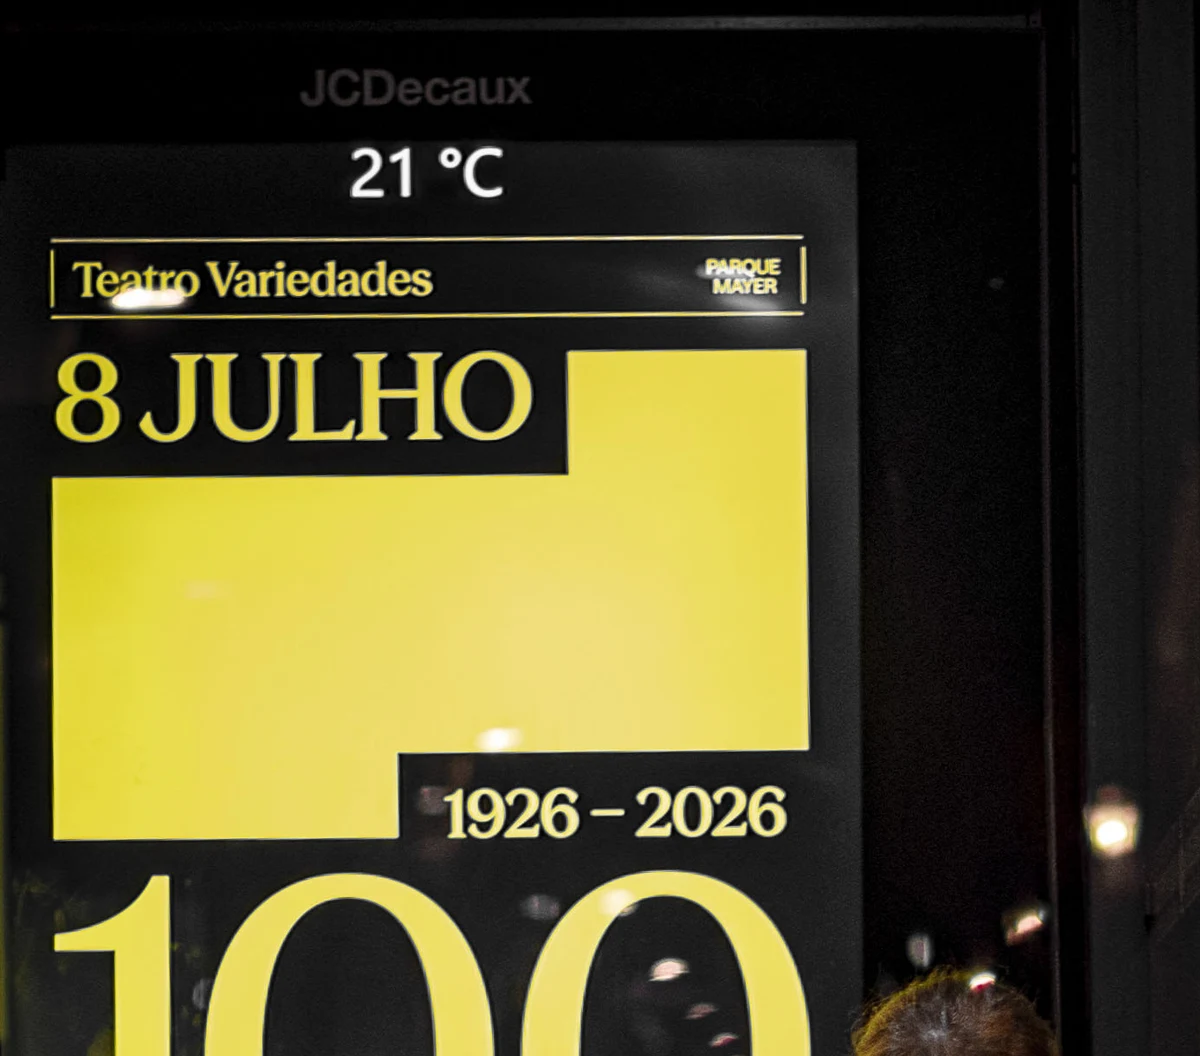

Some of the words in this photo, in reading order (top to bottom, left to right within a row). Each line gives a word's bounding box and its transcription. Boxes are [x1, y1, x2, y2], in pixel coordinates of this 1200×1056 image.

[301, 69, 531, 107] JCDecaux
[350, 147, 411, 199] 21
[438, 146, 504, 199] °C
[72, 259, 199, 300] Teatro
[205, 259, 434, 300] Variedades
[704, 257, 782, 277] PARQUE
[712, 277, 778, 295] MAYER
[54, 350, 121, 444] 8
[138, 350, 534, 444] JULHO
[443, 785, 580, 840] 1926
[634, 785, 788, 840] 2026
